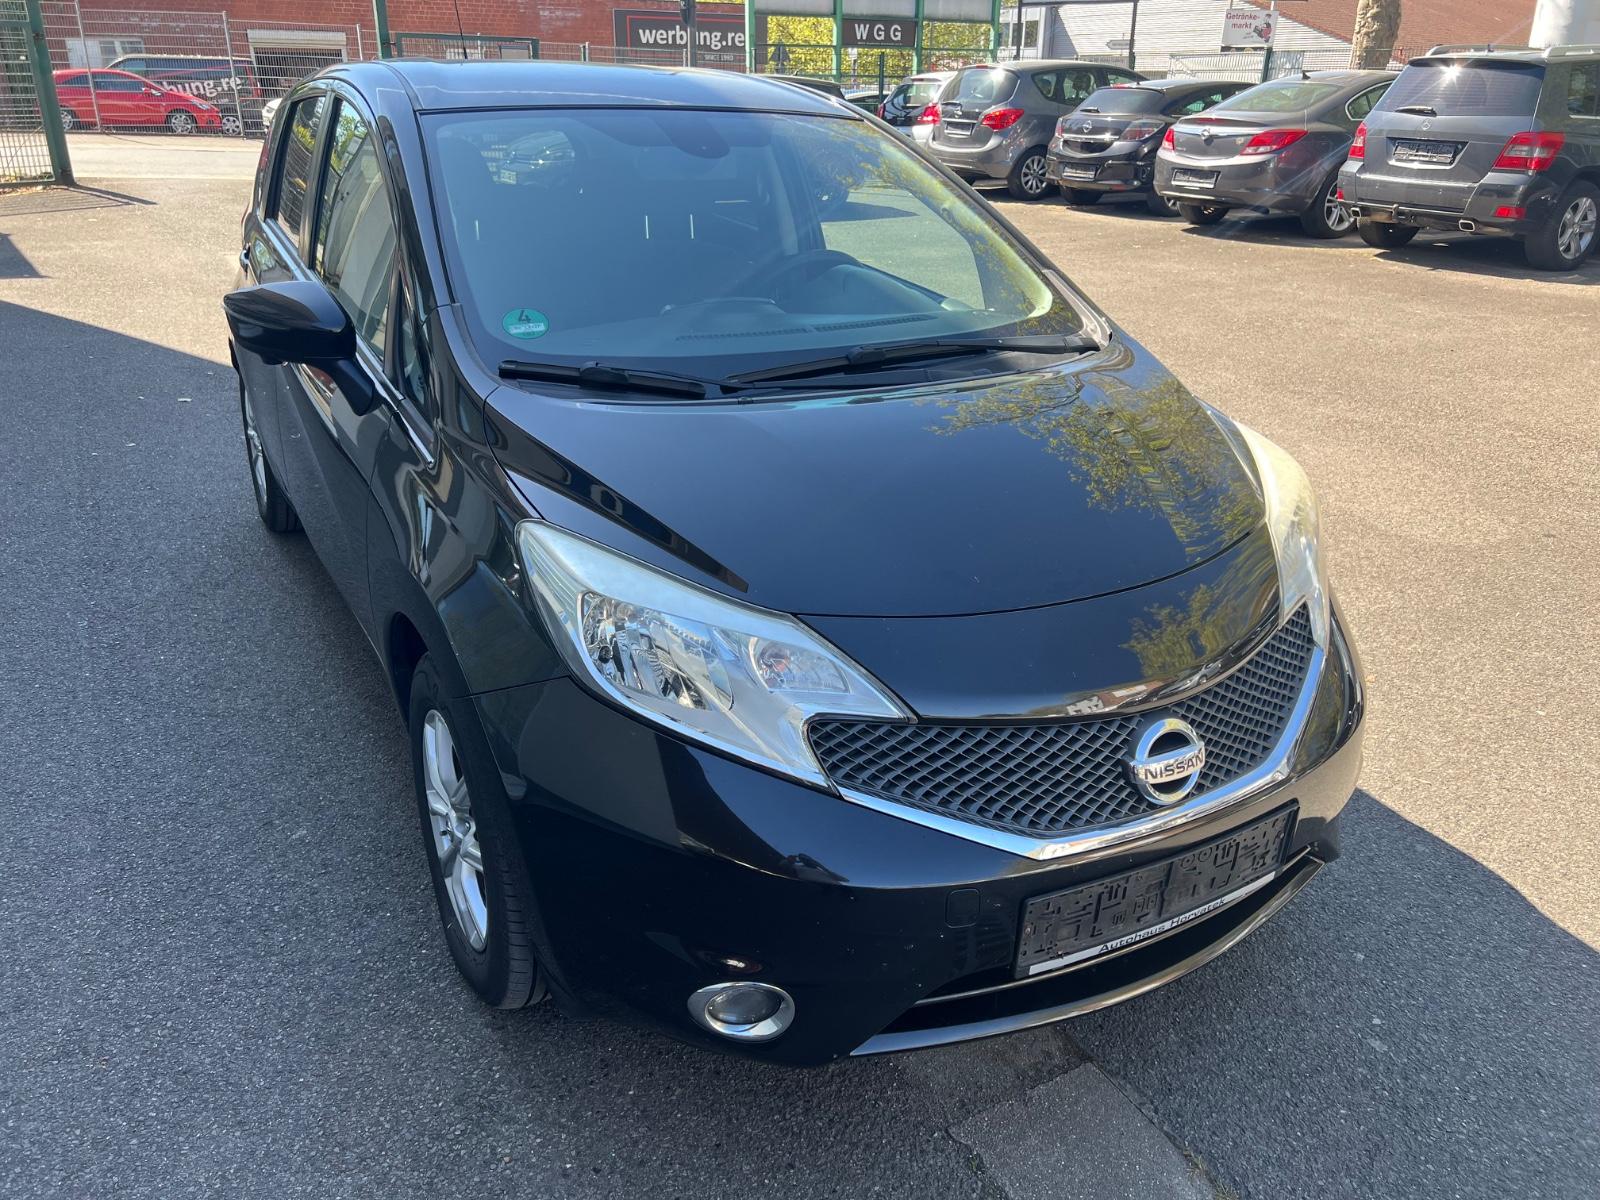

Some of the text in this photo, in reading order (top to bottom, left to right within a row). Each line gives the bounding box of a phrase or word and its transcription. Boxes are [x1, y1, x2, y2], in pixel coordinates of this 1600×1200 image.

[518, 309, 532, 324] 4
[1144, 748, 1204, 780] NISSAN
[1098, 926, 1166, 953] Autohaus
